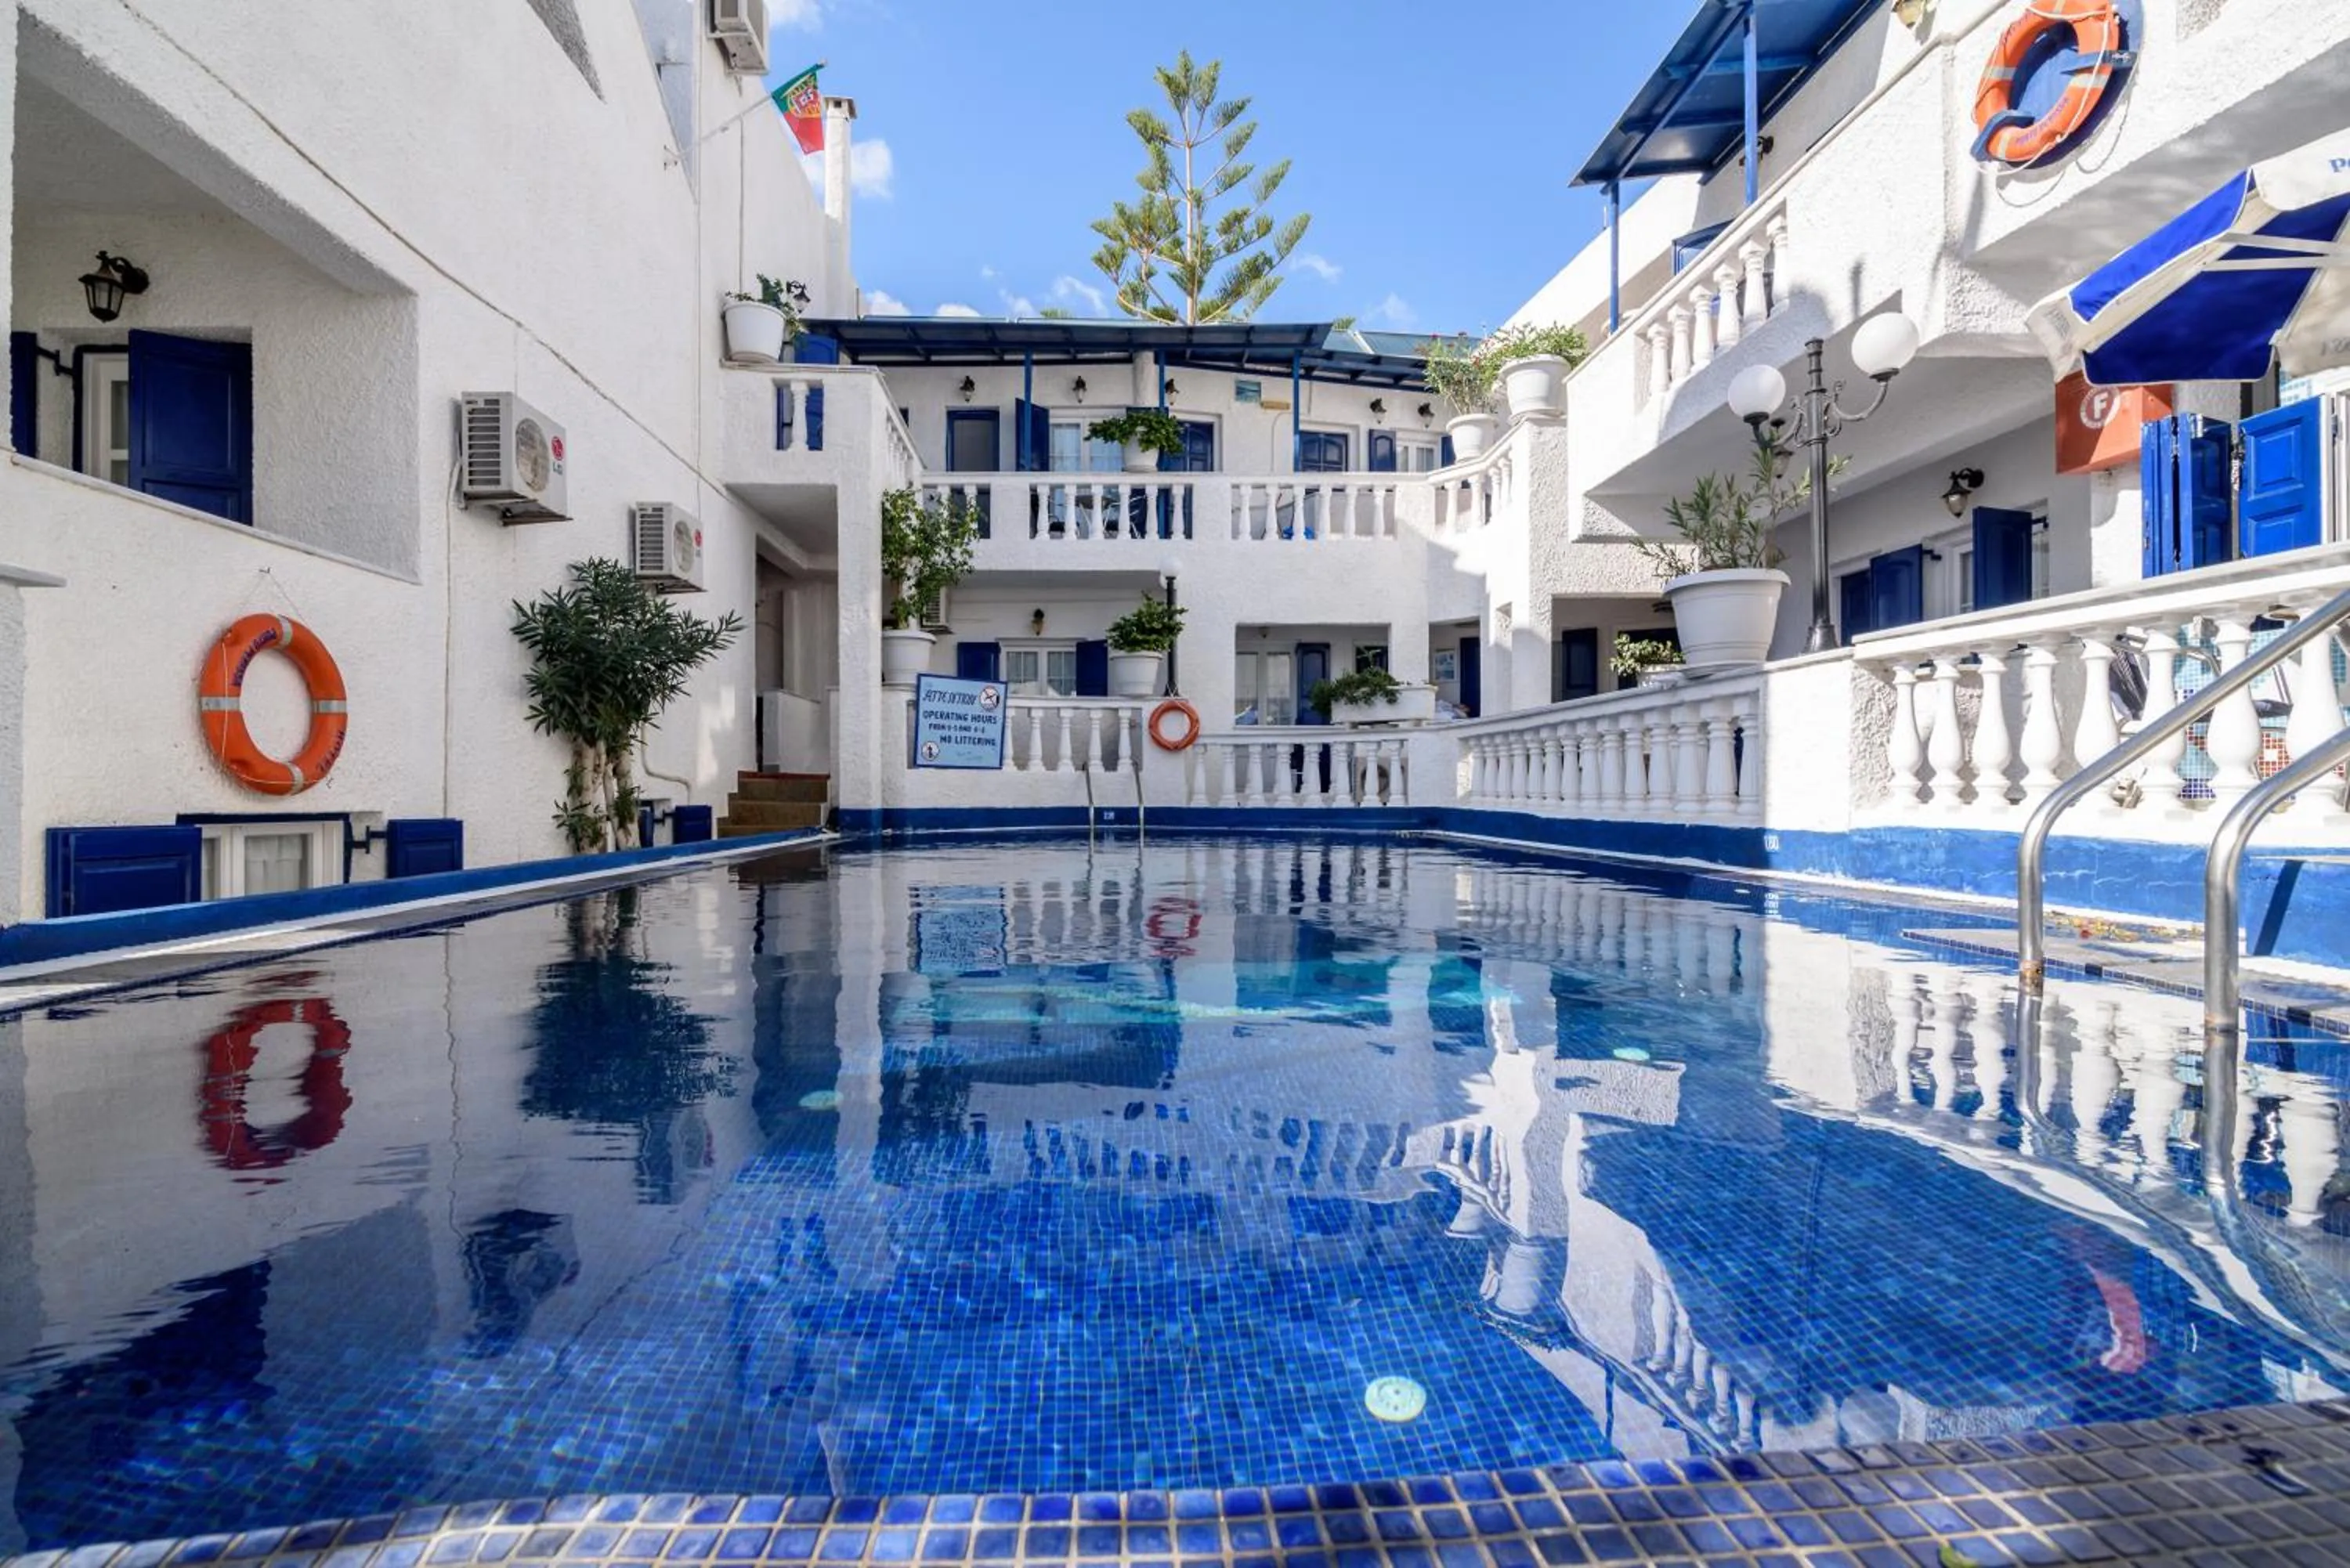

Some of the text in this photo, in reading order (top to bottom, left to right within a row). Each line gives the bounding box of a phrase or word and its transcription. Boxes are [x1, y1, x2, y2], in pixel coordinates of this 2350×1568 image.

[2093, 392, 2109, 419] F
[923, 710, 997, 724] OPERATING HOURS
[939, 735, 996, 746] NO LITTERING
